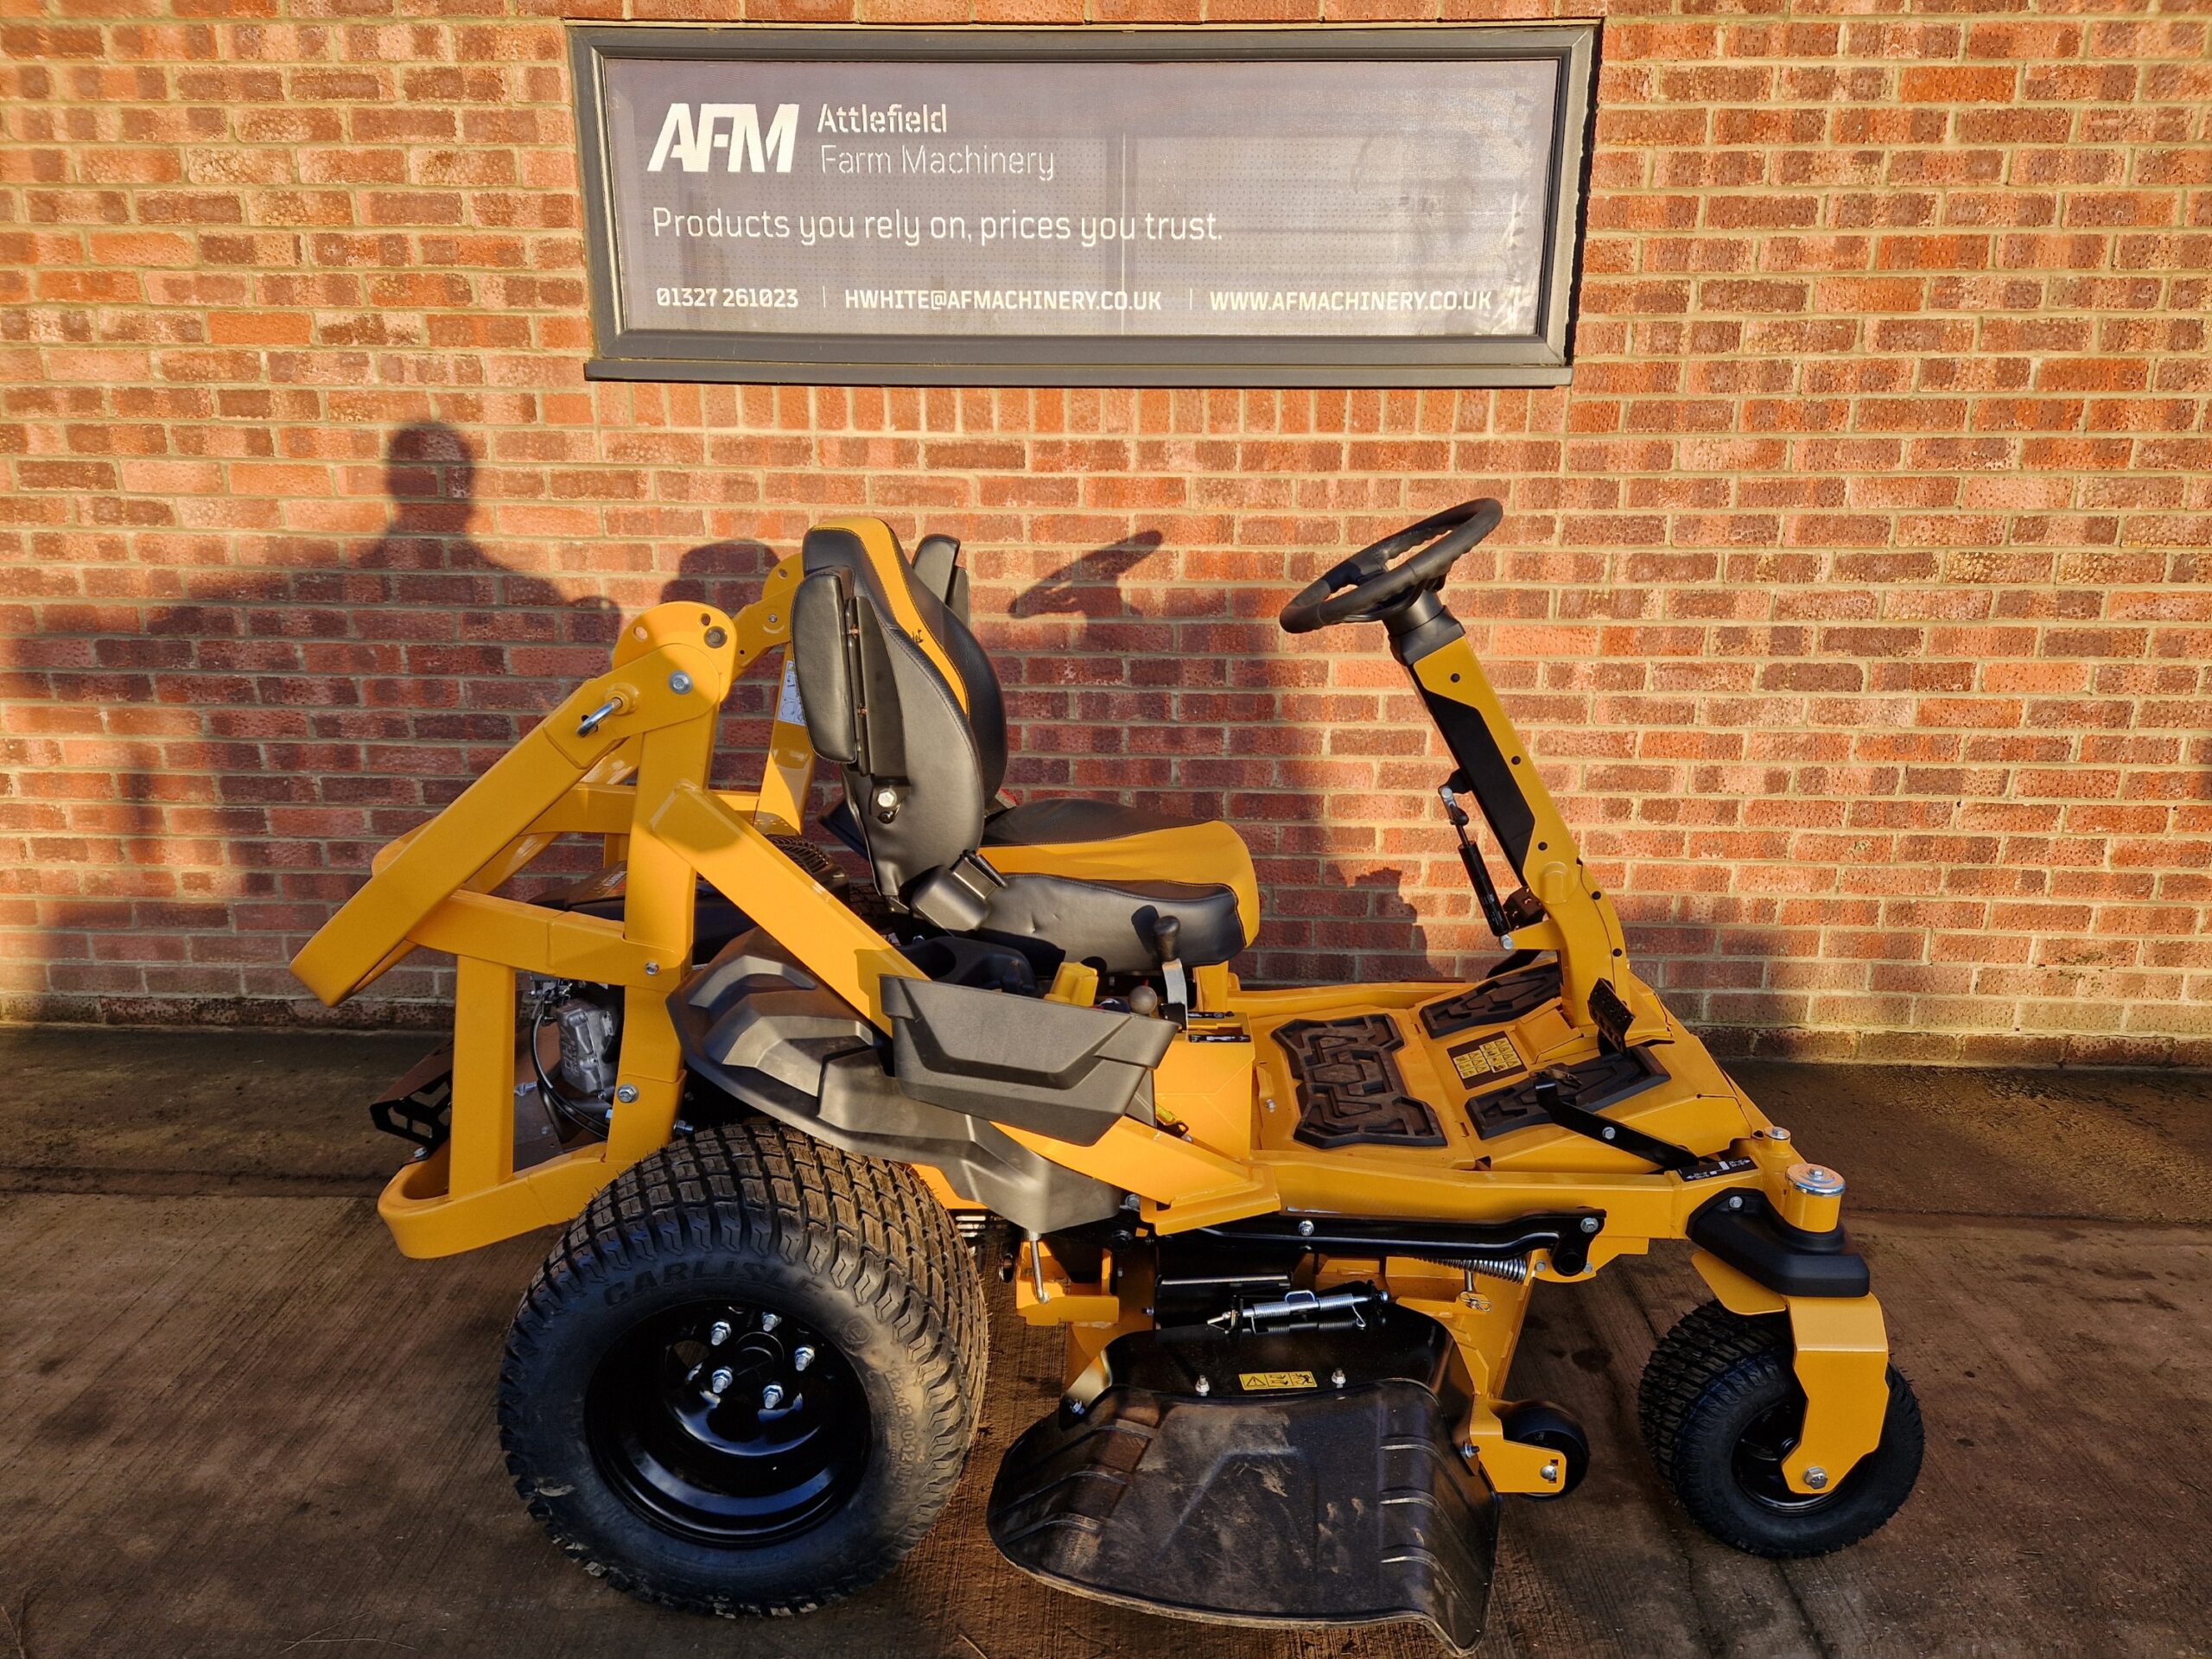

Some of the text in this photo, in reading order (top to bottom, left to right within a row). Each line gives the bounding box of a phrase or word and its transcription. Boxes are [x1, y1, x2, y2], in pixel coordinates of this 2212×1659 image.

[817, 103, 948, 133] Attlefield
[647, 103, 800, 173] AFM
[820, 144, 1054, 181] Farm Machinery
[652, 207, 1223, 247] Products you rely on, prices you trust.
[656, 287, 799, 308] 01327 261023
[844, 289, 1162, 311] HWHITE@AFMACHINERY.CO.UK
[1210, 290, 1493, 312] WWW.AFMACHINERY.CO.UK
[604, 1261, 824, 1307] CARLISLE
